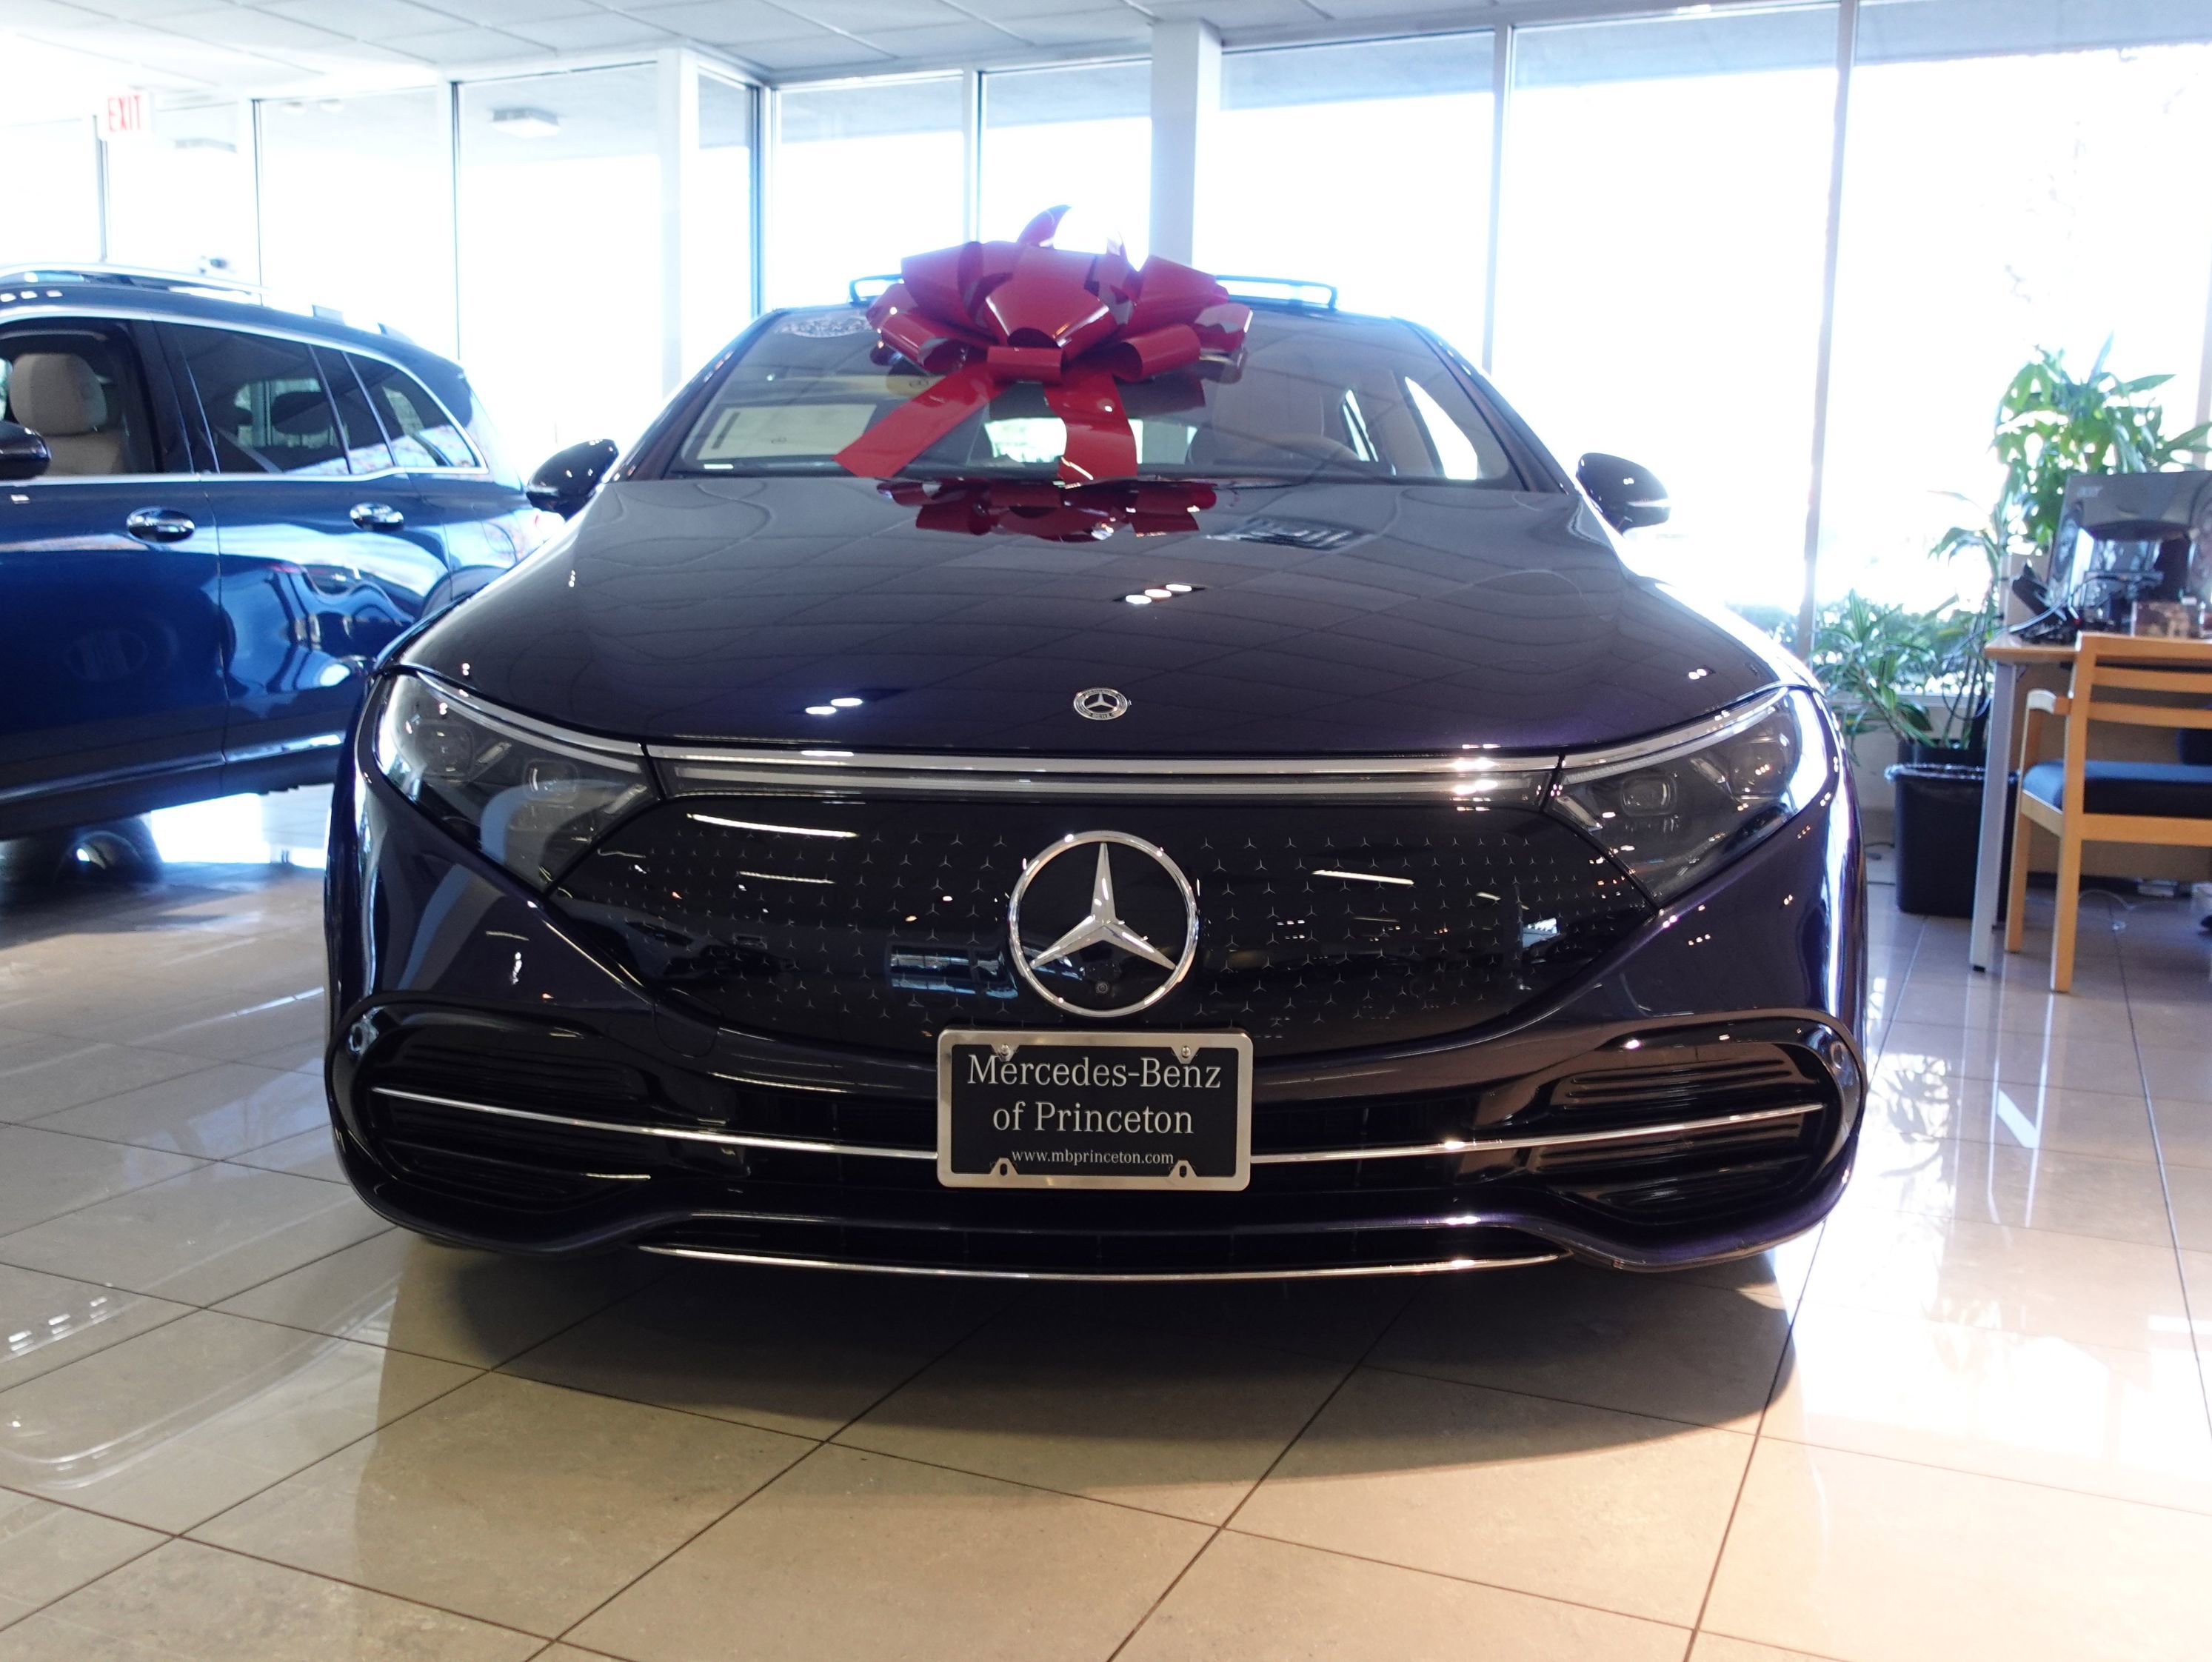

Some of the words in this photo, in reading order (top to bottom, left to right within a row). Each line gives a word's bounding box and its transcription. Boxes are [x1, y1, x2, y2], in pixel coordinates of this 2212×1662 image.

[107, 94, 141, 133] EXIT
[967, 1054, 1221, 1088] Mercedes-Benz
[993, 1101, 1026, 1131] of
[1035, 1101, 1194, 1134] Princeton
[1012, 1149, 1174, 1165] www.mbprinceton.com
